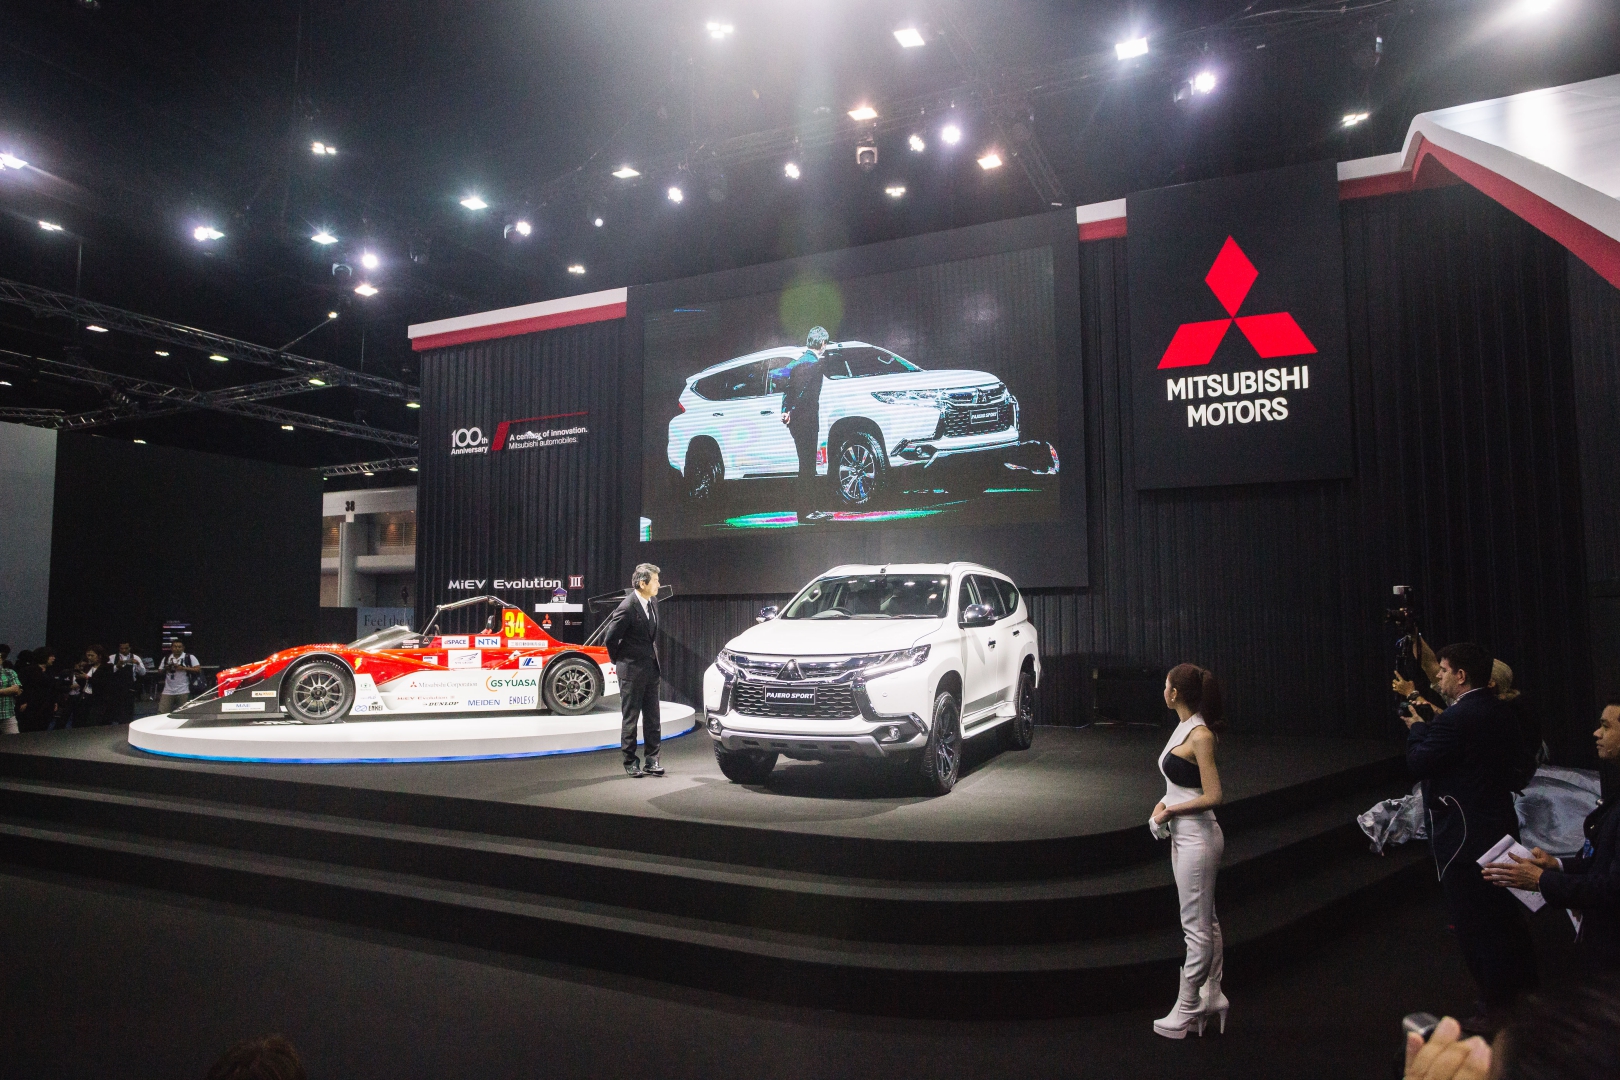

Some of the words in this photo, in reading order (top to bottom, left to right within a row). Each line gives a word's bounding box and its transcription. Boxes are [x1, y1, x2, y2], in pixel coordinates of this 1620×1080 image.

[1166, 365, 1309, 401] MITSUBISHI
[1187, 397, 1289, 428] MOTORS
[509, 434, 515, 442] A
[542, 430, 550, 438] of
[550, 426, 588, 437] innovation.
[451, 445, 489, 455] Anniversary
[508, 439, 539, 450] Mitsubishi
[345, 500, 355, 512] 38
[447, 579, 487, 590] MiEV
[493, 577, 562, 589] Evolution
[364, 614, 386, 626] Feel
[505, 611, 525, 638] 34
[477, 638, 498, 646] NTN
[490, 679, 503, 687] GS
[504, 679, 537, 687] YUASA
[508, 696, 535, 705] ENDLESS
